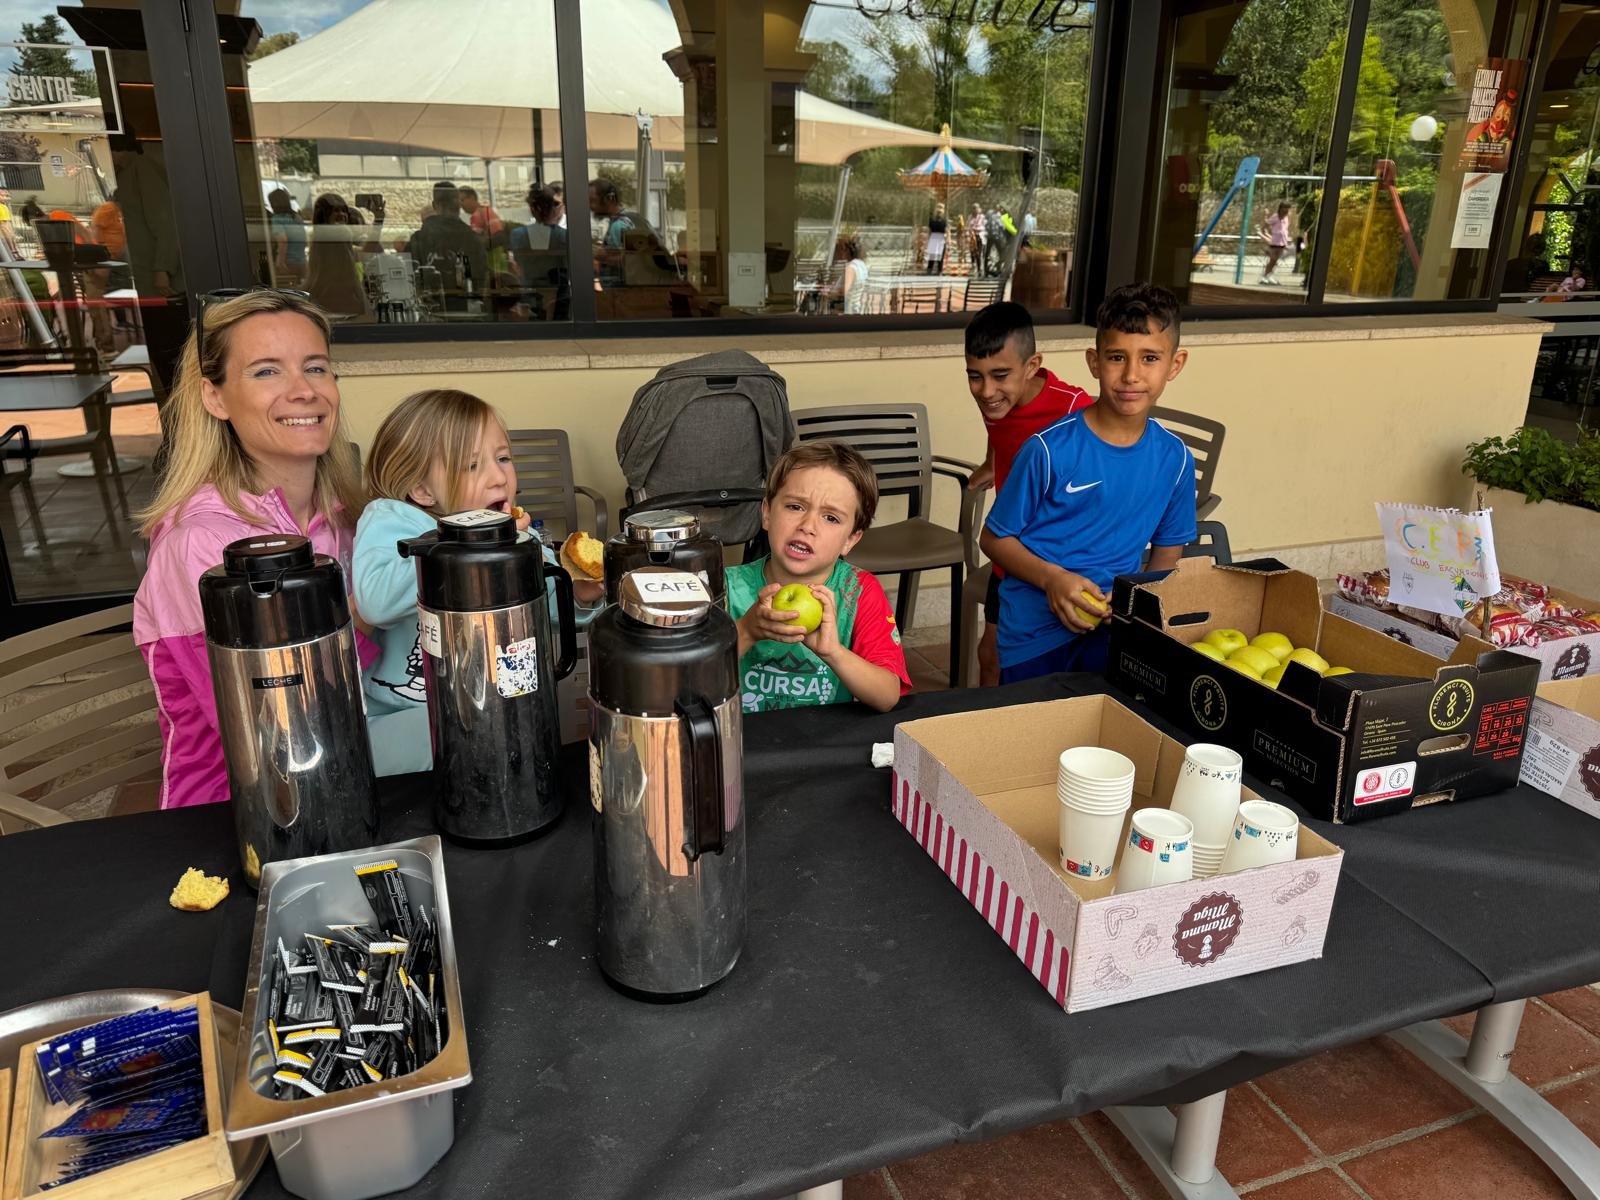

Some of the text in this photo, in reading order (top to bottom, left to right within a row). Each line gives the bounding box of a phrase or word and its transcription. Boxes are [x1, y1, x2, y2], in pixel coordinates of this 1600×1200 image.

[7, 74, 80, 102] CENTRE
[645, 580, 701, 592] CAFÉ
[262, 677, 294, 687] LECHE
[1122, 657, 1162, 687] PREMIUM
[1555, 662, 1586, 677] Mamma
[744, 671, 821, 697] CURSA
[1432, 682, 1471, 710] FLORENCI FRUITS
[1436, 716, 1461, 727] GIRONA
[1258, 737, 1311, 774] PREMIUM
[1193, 902, 1230, 921] Miga
[1181, 914, 1237, 940] Mamma
